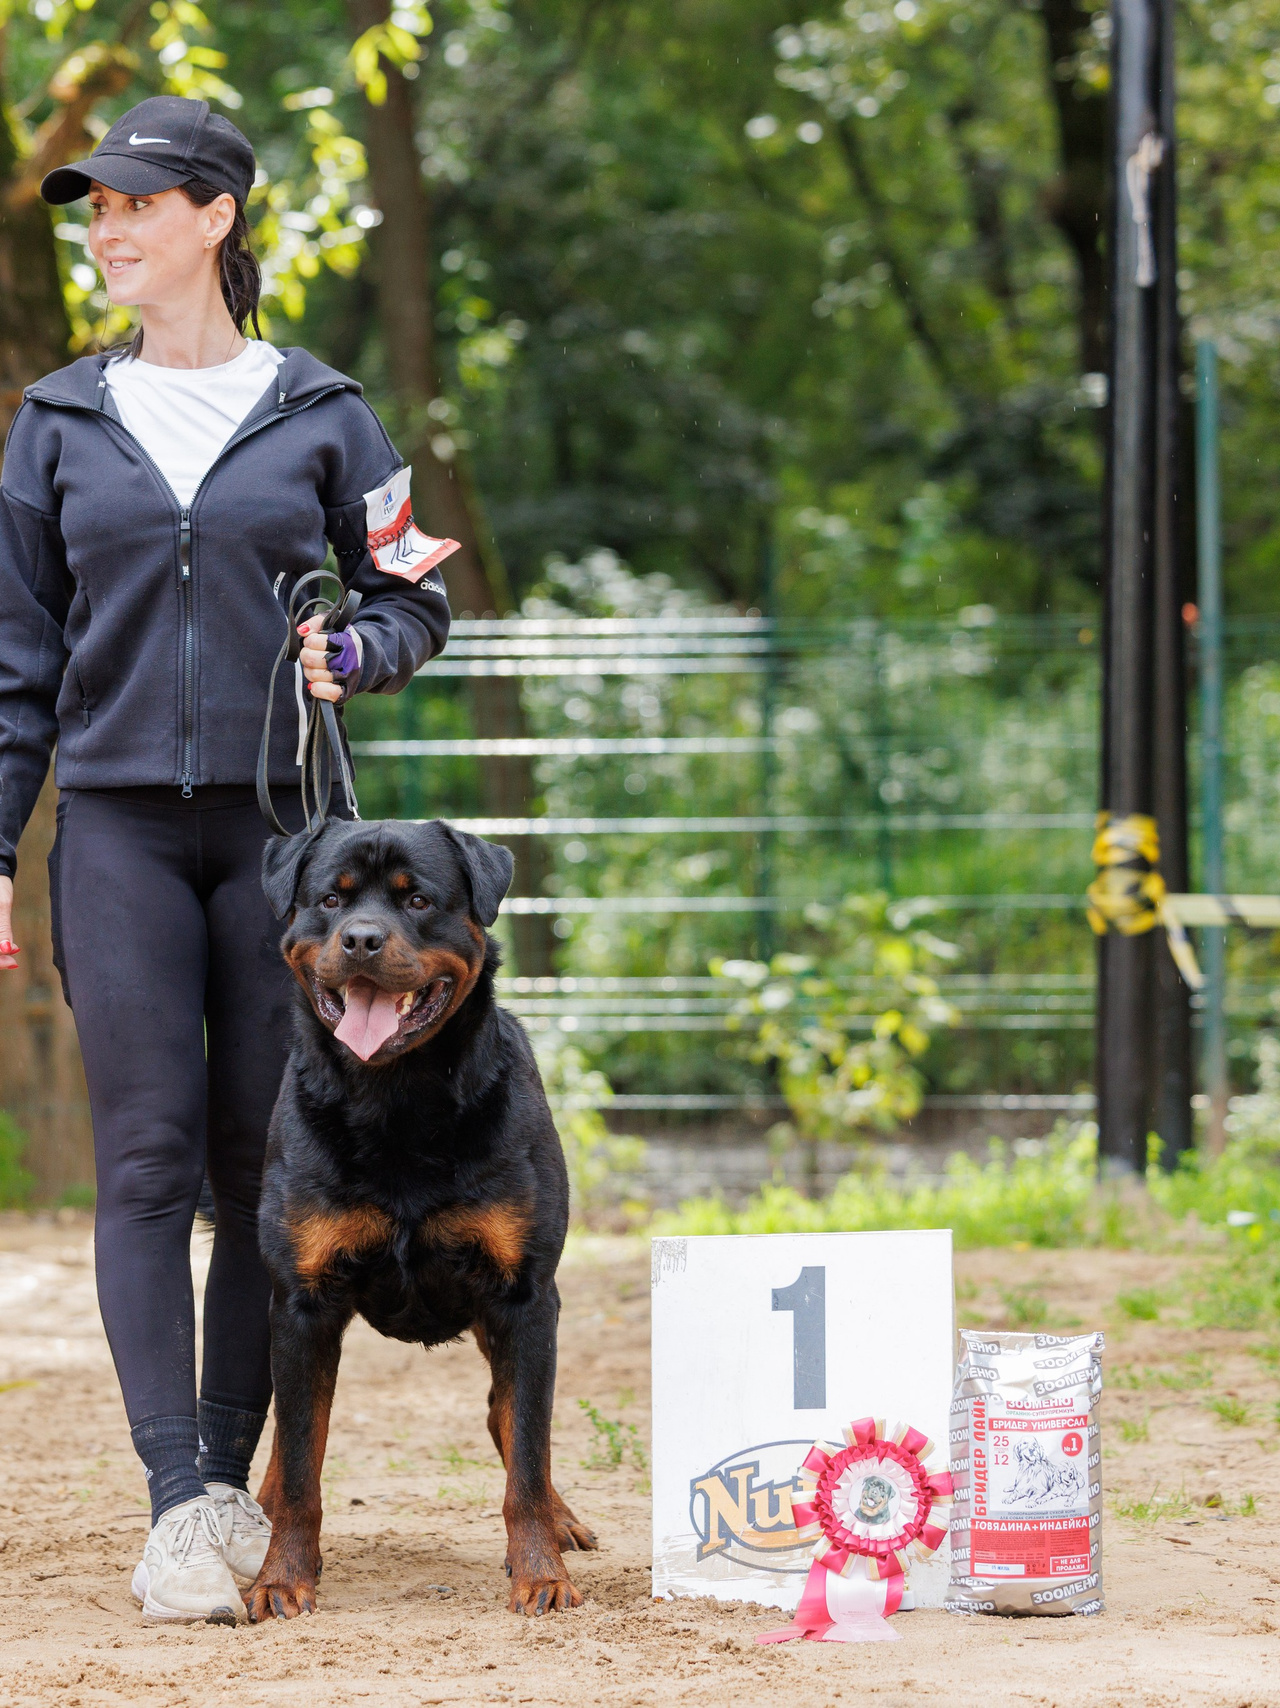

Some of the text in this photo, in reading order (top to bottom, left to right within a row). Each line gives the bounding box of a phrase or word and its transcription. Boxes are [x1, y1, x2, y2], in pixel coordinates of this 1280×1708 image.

[771, 1265, 826, 1410] 1
[992, 1418, 1085, 1431] БРИДЕР УНИВЕРСАЛ
[993, 1435, 1010, 1447] 25
[994, 1454, 1009, 1466] 12
[974, 1449, 988, 1516] БРИДЕР
[975, 1518, 1088, 1532] ГОВЯДИНА+ИНДЕЙКА
[1056, 1563, 1085, 1572] ПРОДАЖИ
